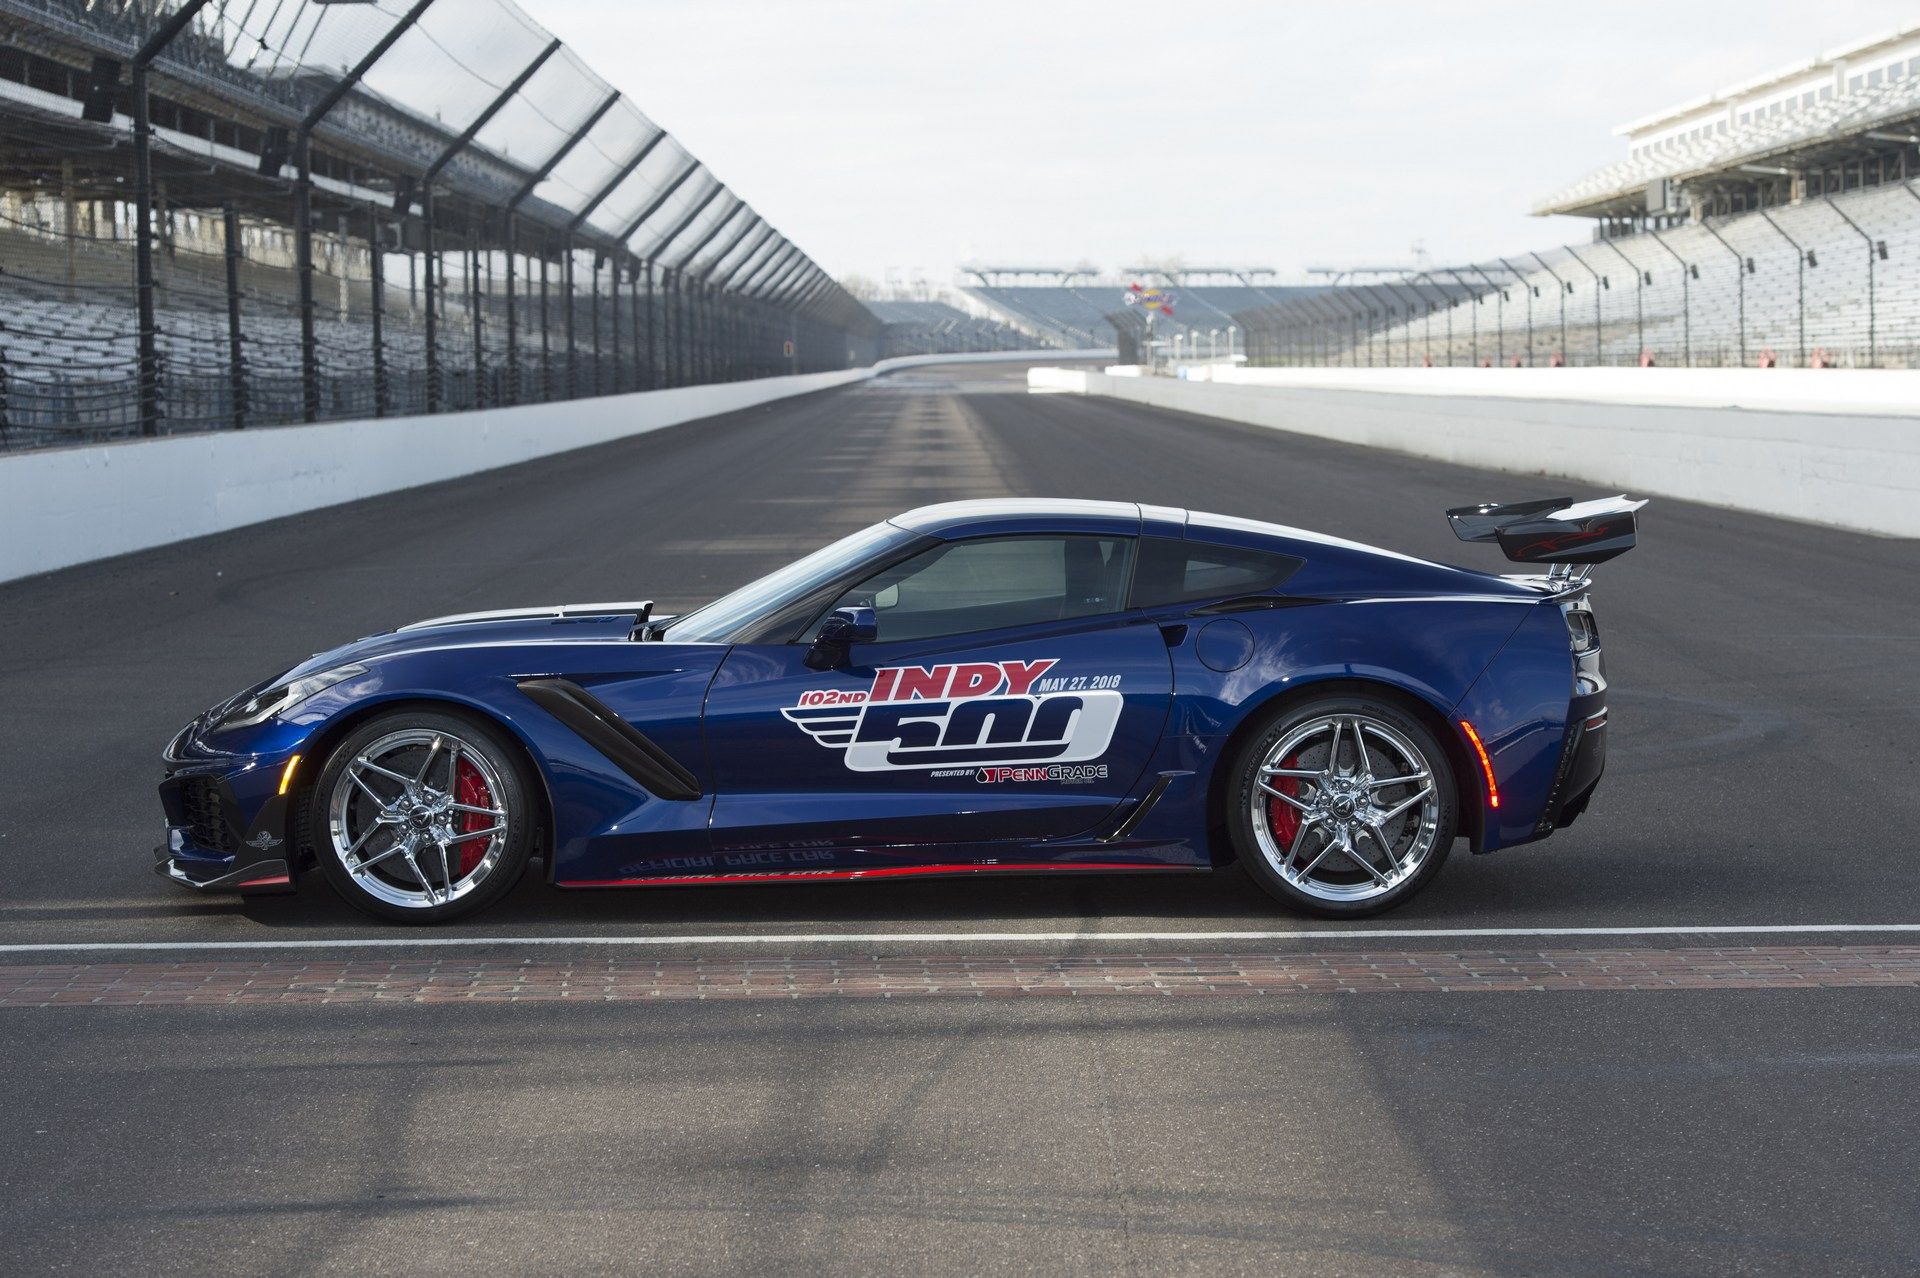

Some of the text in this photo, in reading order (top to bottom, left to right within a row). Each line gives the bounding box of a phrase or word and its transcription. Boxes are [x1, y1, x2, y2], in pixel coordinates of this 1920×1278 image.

[867, 658, 1060, 702] INDY
[1038, 674, 1122, 692] MAY 27. 2018
[798, 689, 869, 706] 102ND
[844, 690, 1124, 771] 500
[930, 769, 965, 778] PRESENTED
